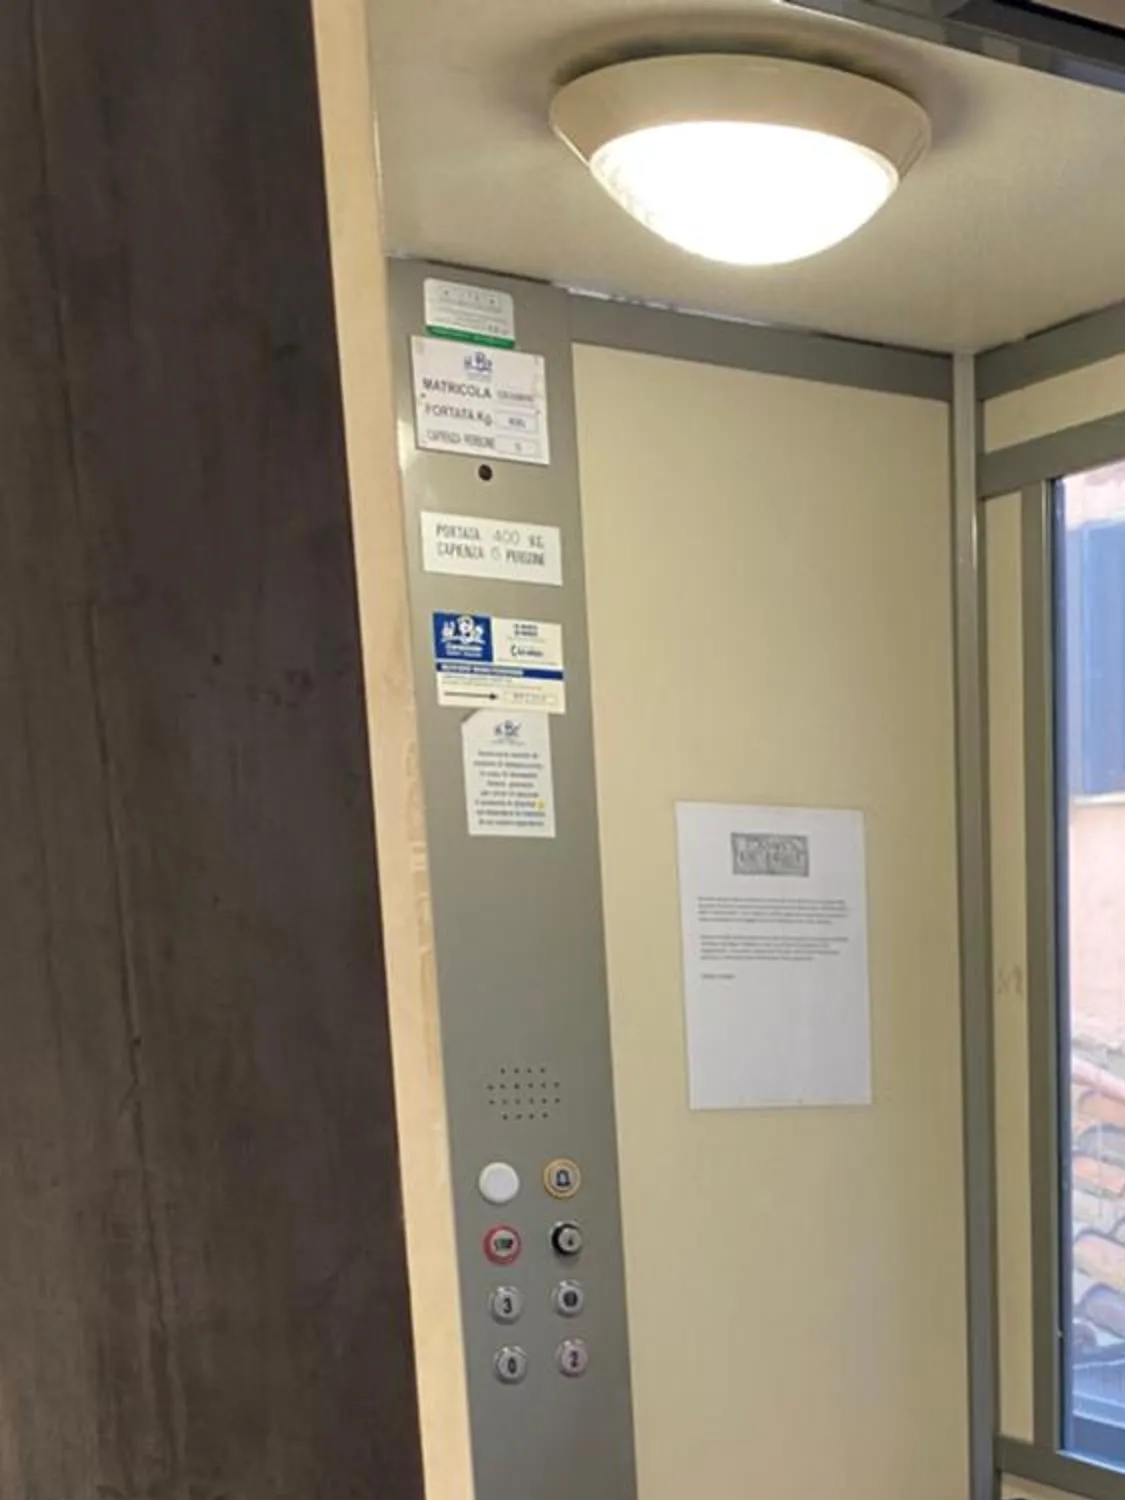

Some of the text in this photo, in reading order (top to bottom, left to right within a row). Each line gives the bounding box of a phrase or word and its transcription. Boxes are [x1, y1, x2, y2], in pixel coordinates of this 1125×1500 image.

[422, 377, 492, 399] MATRICOLA
[424, 402, 475, 421] PORTATA
[435, 523, 480, 541] PORTATA
